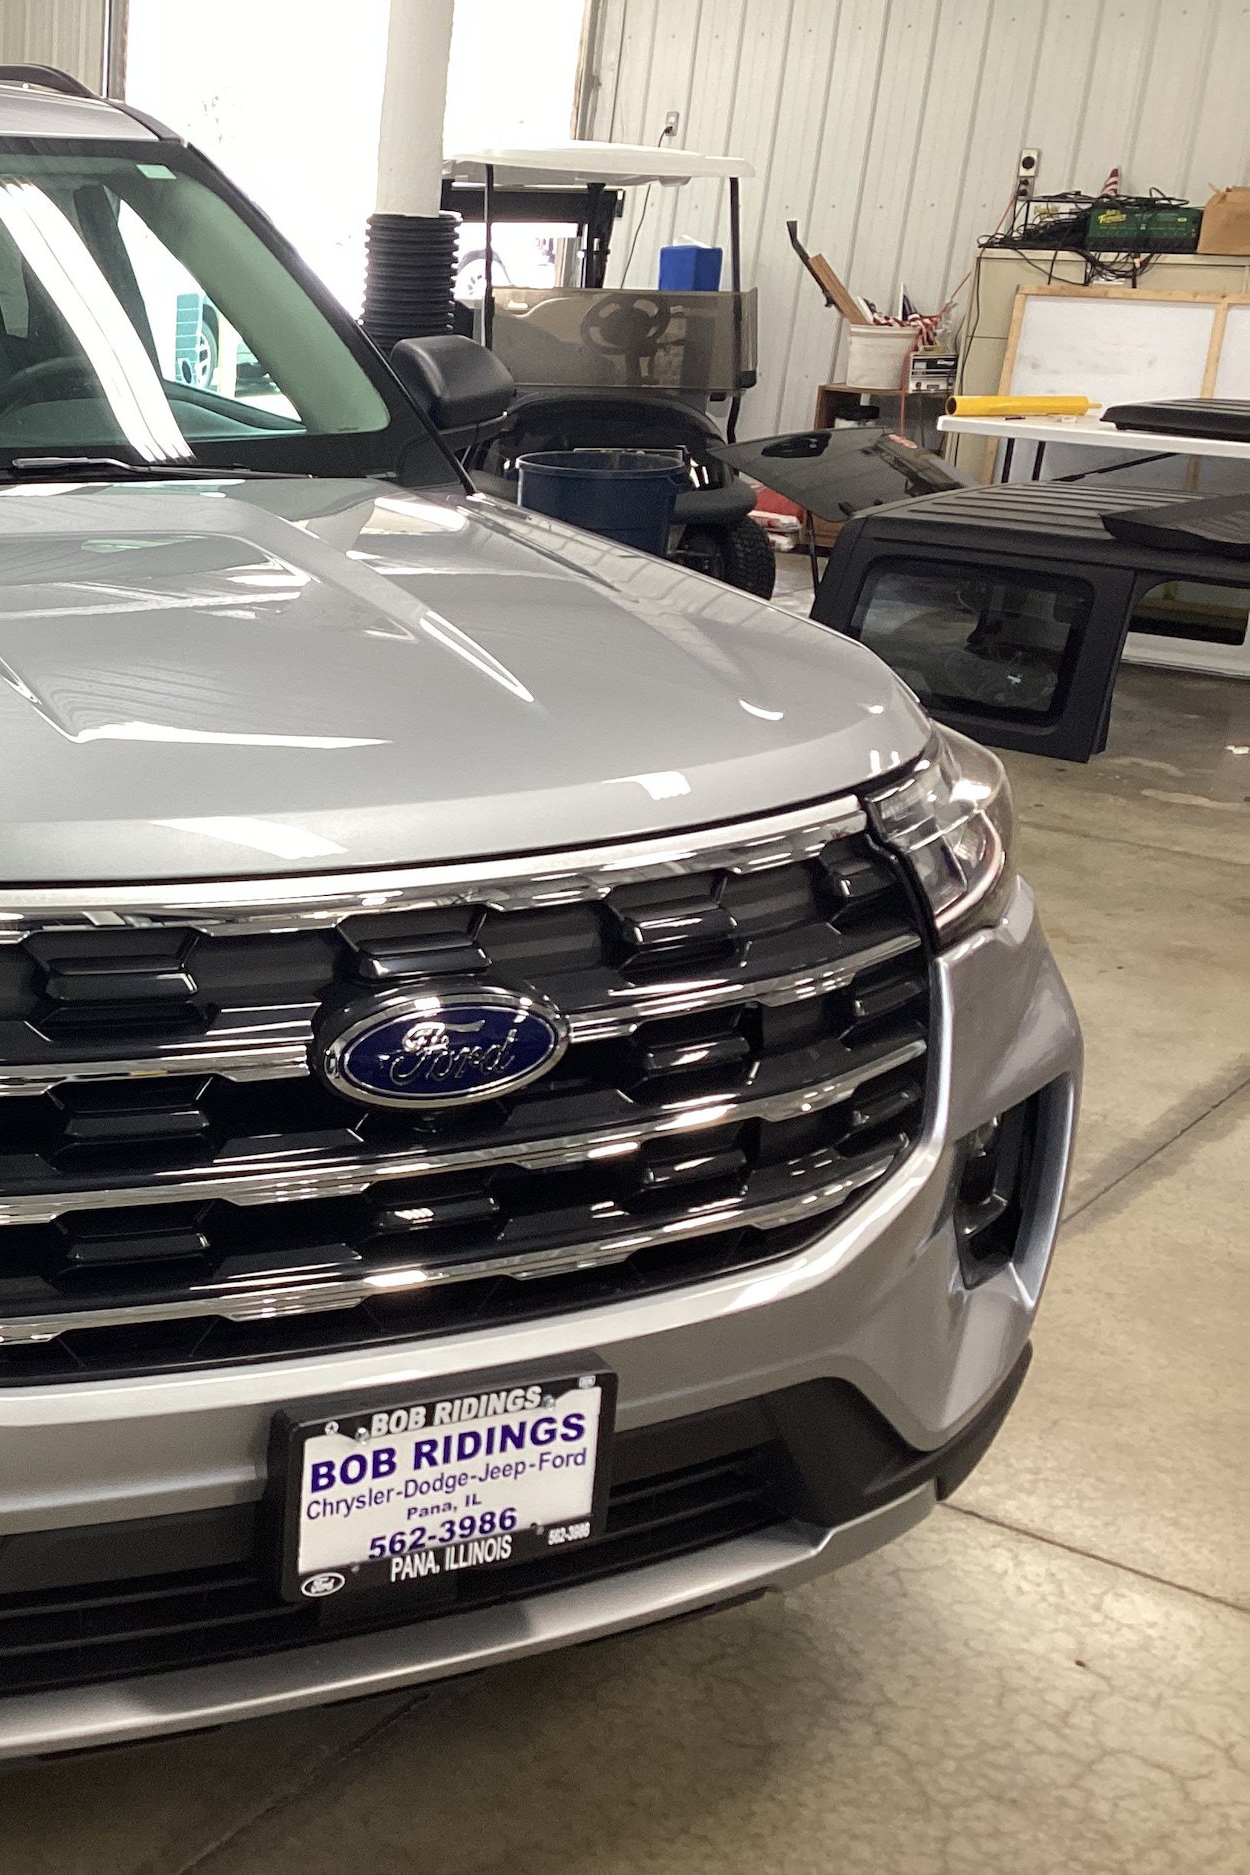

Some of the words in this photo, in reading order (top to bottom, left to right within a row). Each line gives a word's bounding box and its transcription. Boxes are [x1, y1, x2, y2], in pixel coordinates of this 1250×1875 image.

[384, 1019, 518, 1086] Ford
[371, 1410, 425, 1438] BOB
[432, 1385, 543, 1426] RIDINGS
[310, 1447, 396, 1493] BOB
[413, 1412, 587, 1470] RIDINGS
[306, 1448, 587, 1521] Chrysler-Dodge-Jeep-Ford
[406, 1497, 458, 1521] Pana,
[465, 1491, 483, 1507] IL
[368, 1506, 517, 1559] 562-3986
[444, 1534, 513, 1570] ILLINOIS
